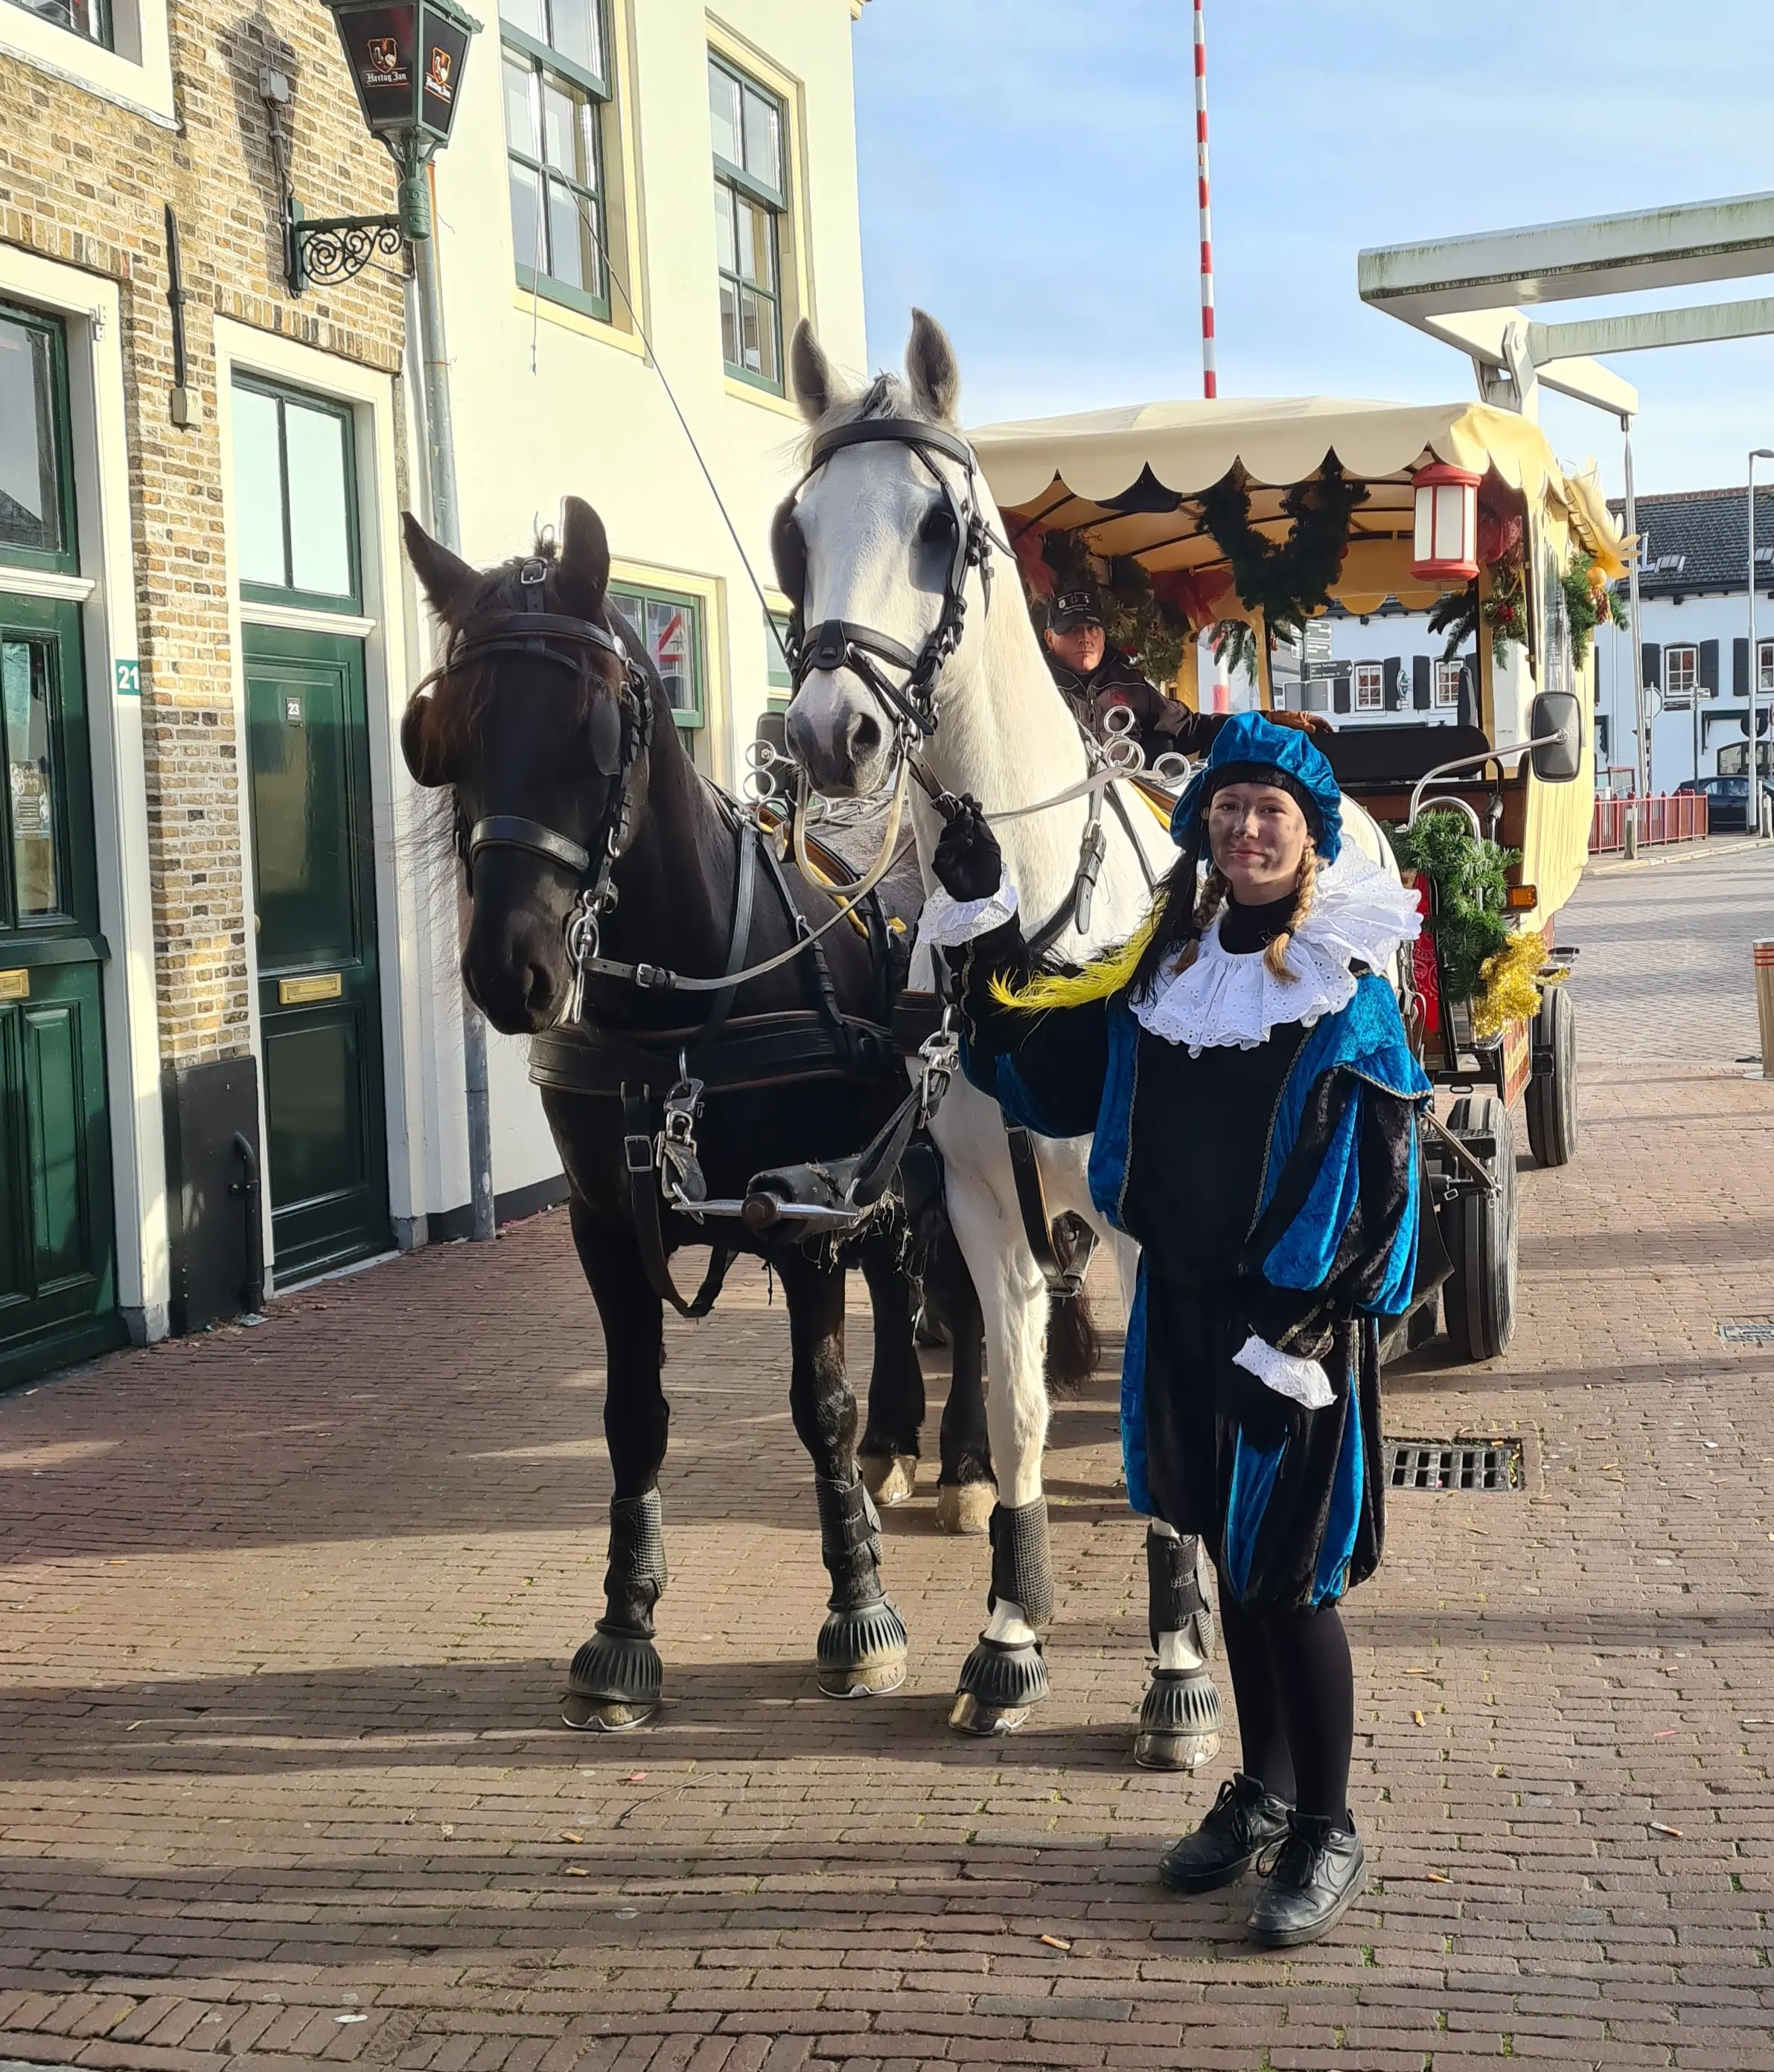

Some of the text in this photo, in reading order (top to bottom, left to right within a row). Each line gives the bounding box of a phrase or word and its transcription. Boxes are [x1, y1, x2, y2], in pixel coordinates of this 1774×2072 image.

[366, 71, 407, 85] Hertog Jan
[118, 665, 139, 690] 21
[287, 703, 299, 715] 23
